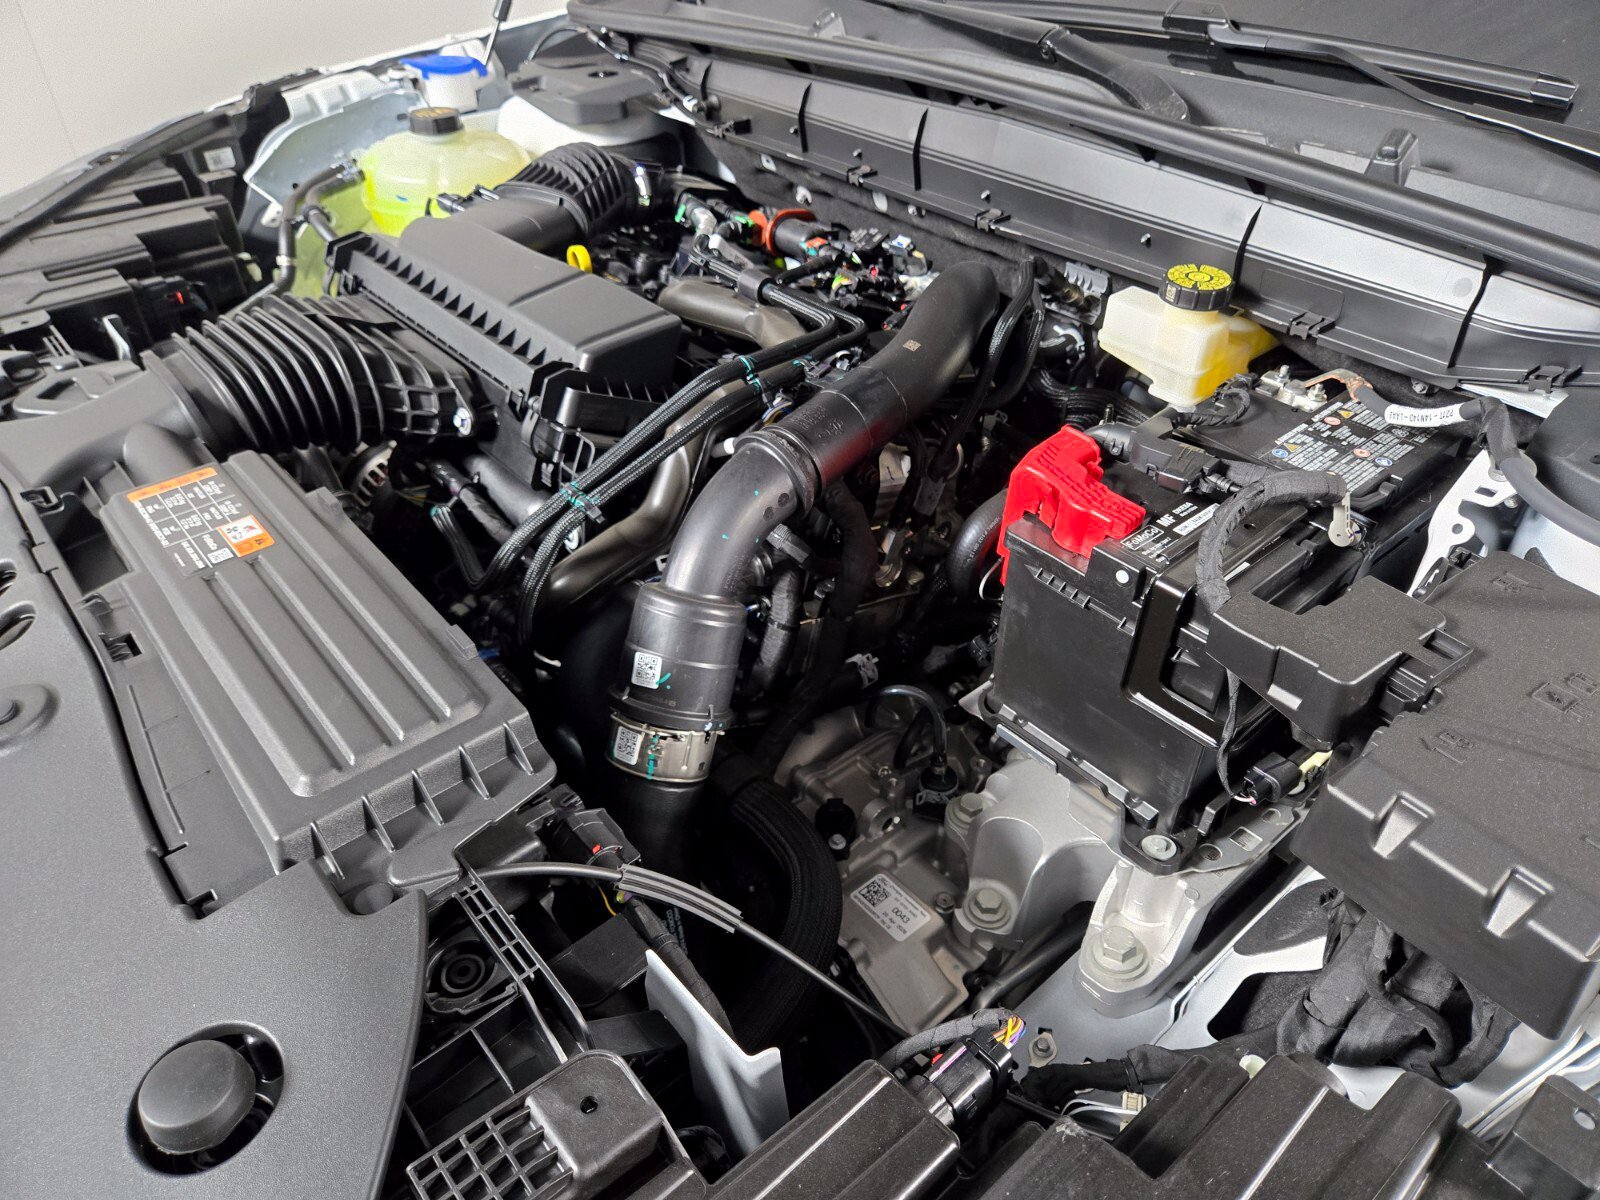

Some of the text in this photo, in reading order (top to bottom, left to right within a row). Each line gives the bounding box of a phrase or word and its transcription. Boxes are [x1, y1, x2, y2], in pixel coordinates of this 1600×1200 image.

[1156, 514, 1176, 527] MF
[1124, 527, 1161, 549] FoMoCo
[892, 907, 910, 924] 0043
